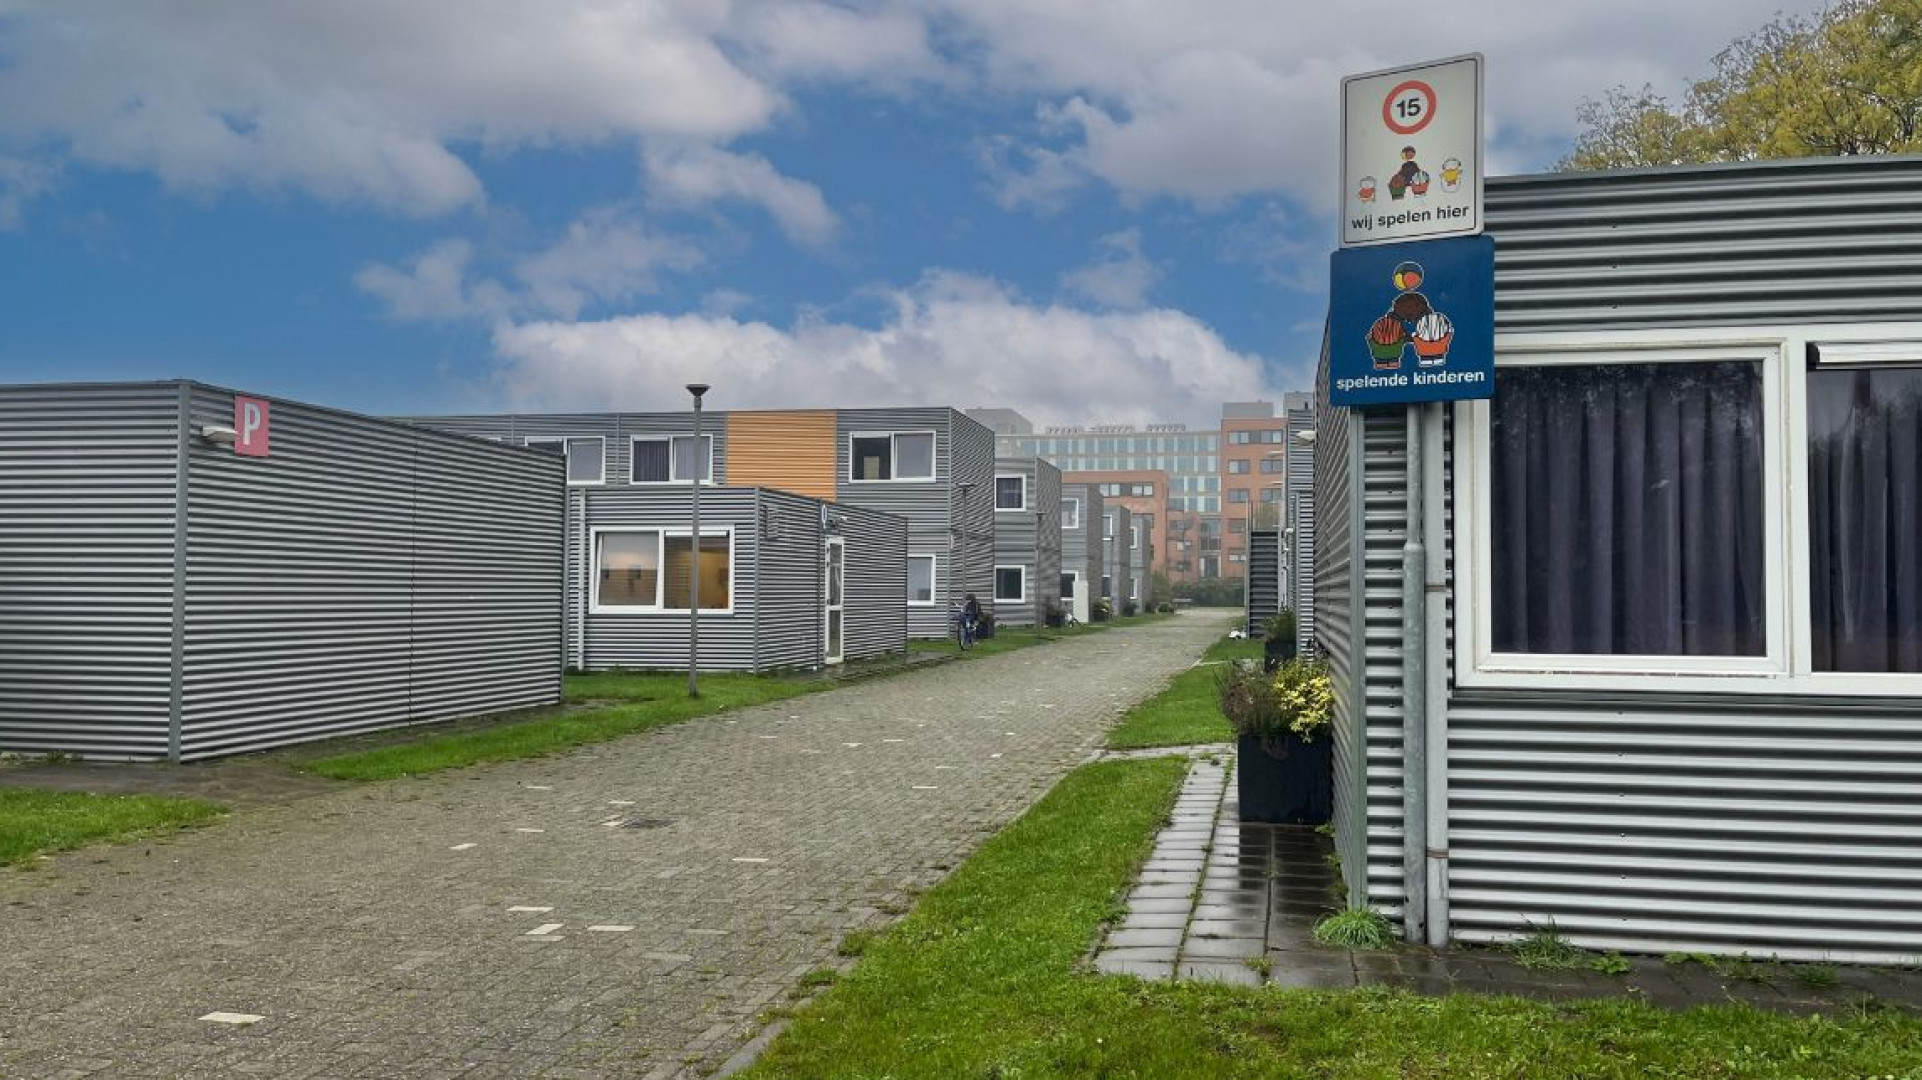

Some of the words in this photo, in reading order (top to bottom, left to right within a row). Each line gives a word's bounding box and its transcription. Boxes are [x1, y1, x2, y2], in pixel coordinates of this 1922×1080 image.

[1397, 97, 1421, 118] 15
[1351, 214, 1373, 231] wij
[1378, 210, 1431, 229] spelen
[1436, 205, 1469, 219] hier
[1336, 373, 1408, 391] spelende
[1413, 370, 1485, 385] kinderen
[243, 402, 261, 445] P
